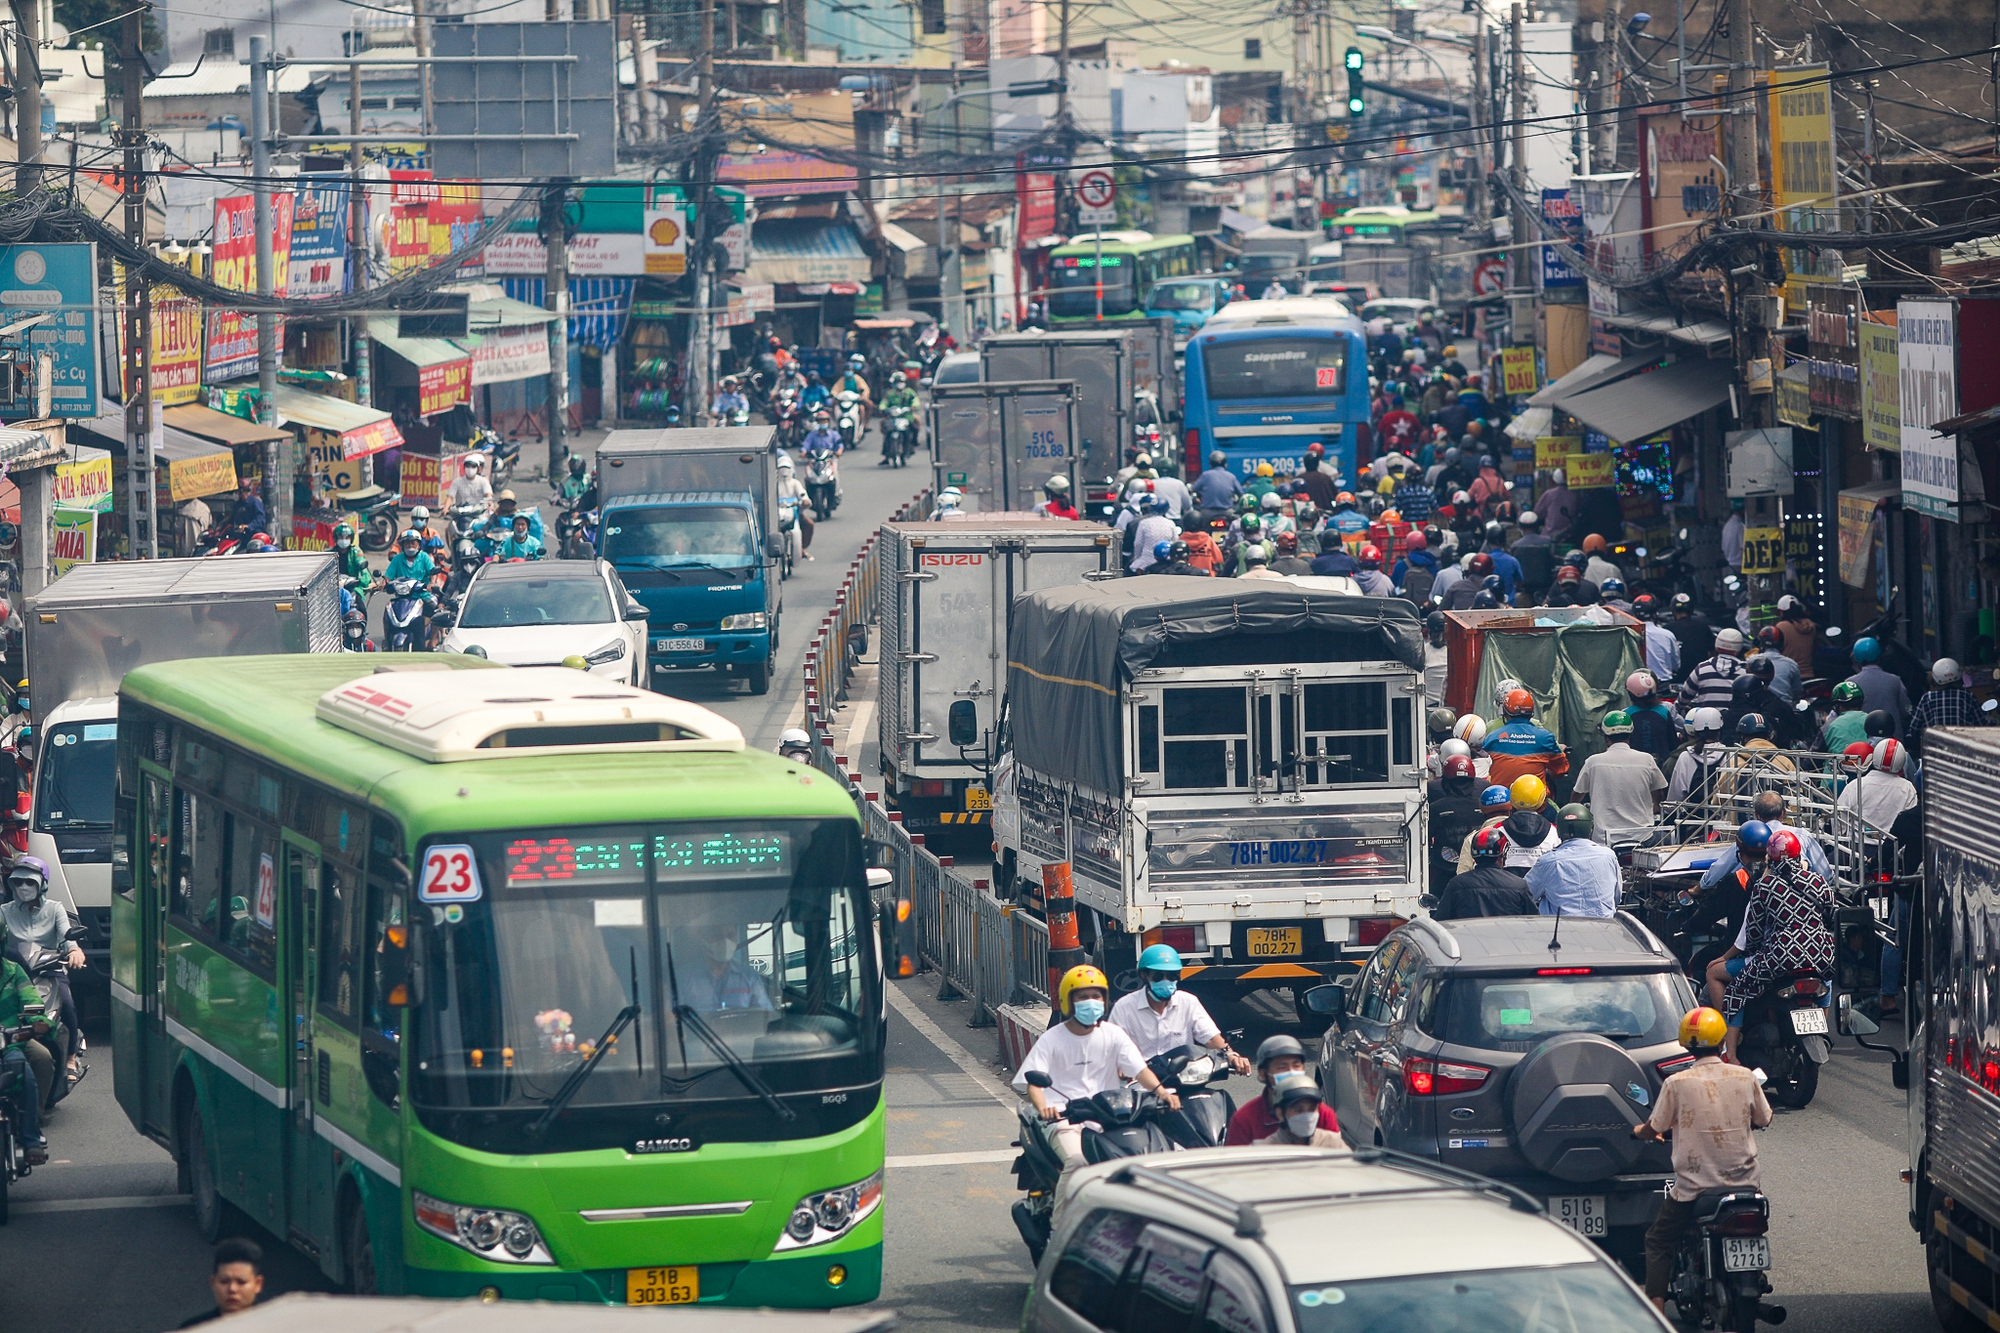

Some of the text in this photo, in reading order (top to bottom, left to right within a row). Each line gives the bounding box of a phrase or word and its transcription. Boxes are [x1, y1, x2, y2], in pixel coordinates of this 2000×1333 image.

[70, 366, 86, 382] Cụ
[1317, 368, 1335, 386] 27
[1032, 431, 1055, 444] 51C
[1026, 444, 1064, 458] 702.88
[80, 473, 97, 498] RAU
[55, 521, 85, 560] MÍA
[1744, 533, 1783, 569] DÉP
[921, 554, 982, 566] ISUZU
[1230, 841, 1327, 865] 78H-002.27
[427, 853, 472, 893] 23
[259, 865, 272, 917] 23
[1263, 930, 1287, 941] 78H
[1254, 943, 1296, 955] 002.27
[635, 1138, 691, 1151] SAMCO
[1561, 1199, 1592, 1216] 51G
[1732, 1253, 1764, 1266] 2726
[647, 1269, 679, 1284] 51B
[635, 1287, 690, 1303] 303.63
